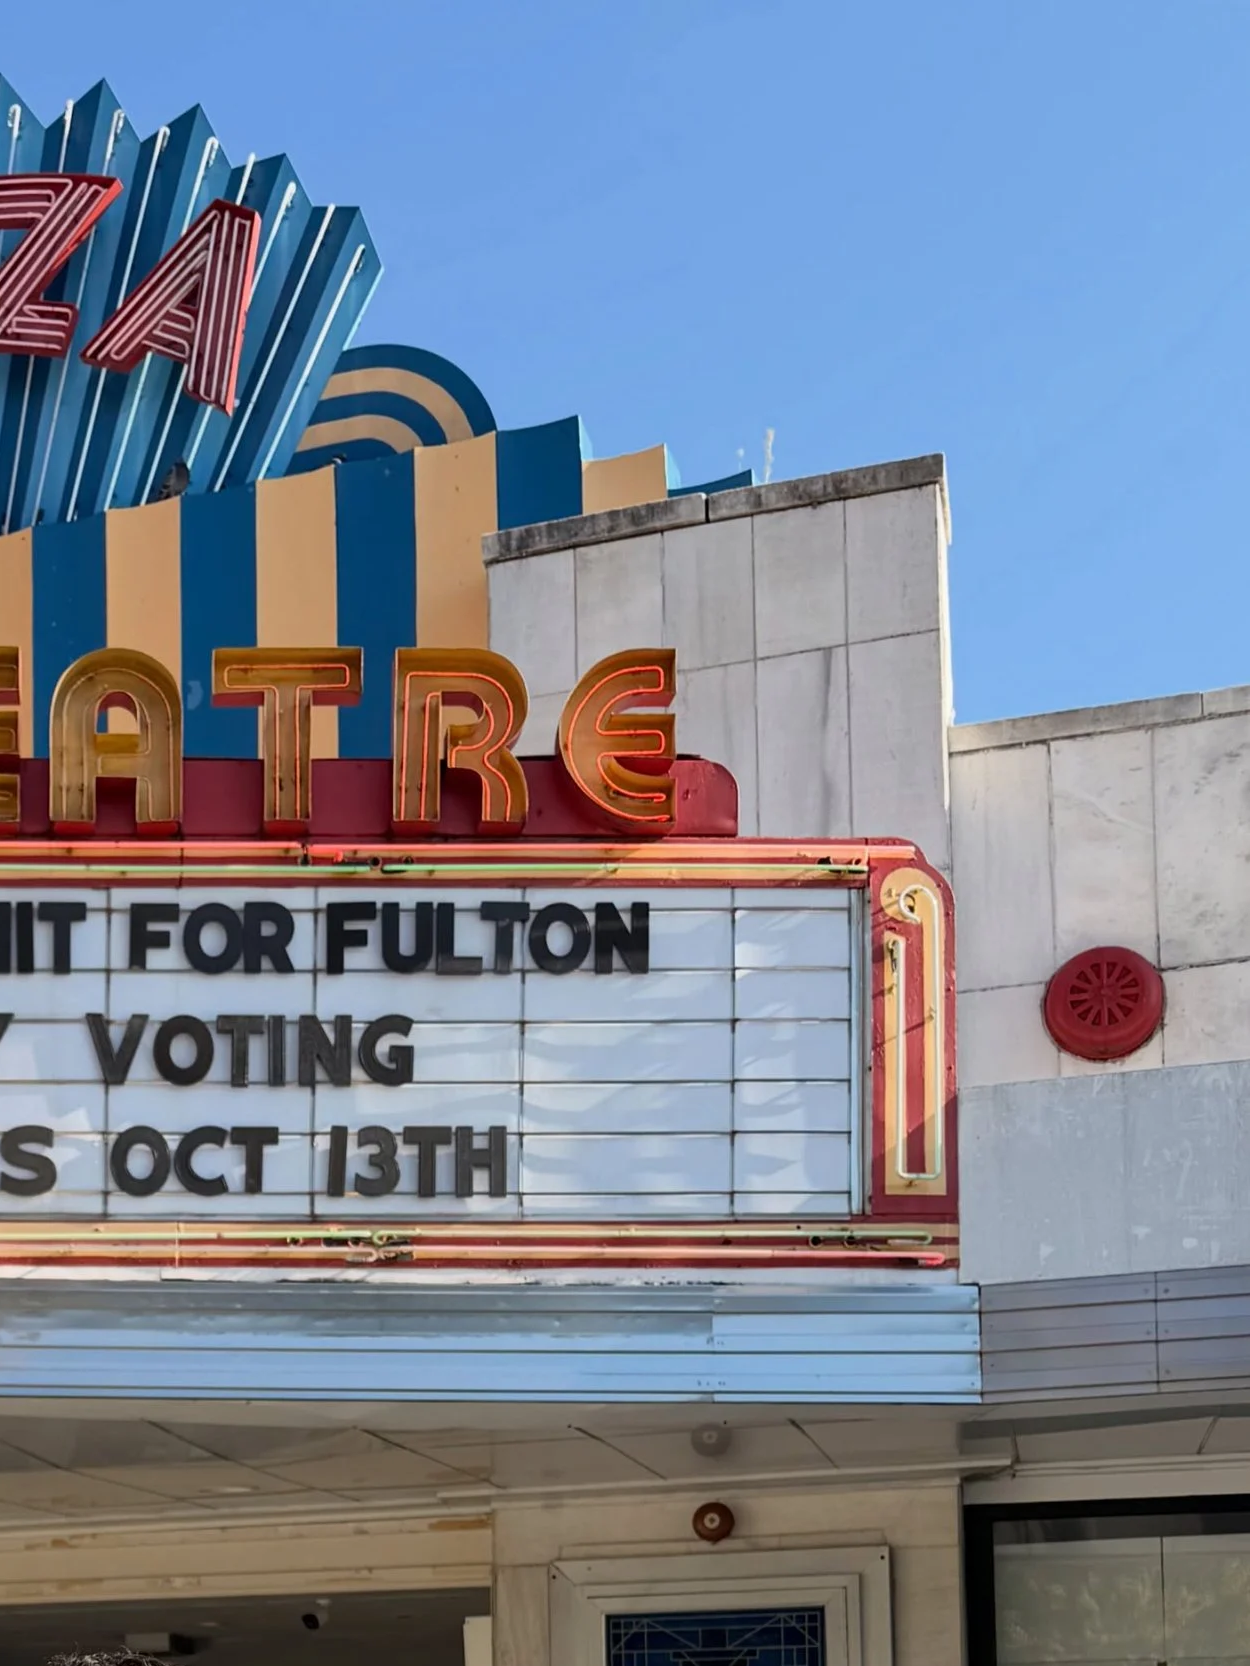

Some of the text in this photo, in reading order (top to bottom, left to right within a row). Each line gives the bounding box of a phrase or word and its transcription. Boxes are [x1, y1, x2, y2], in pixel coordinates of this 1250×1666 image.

[129, 901, 296, 975] FOR
[325, 900, 651, 976] FULTON
[85, 1012, 415, 1088] VOTING
[109, 1124, 280, 1198] OCT
[326, 1125, 507, 1199] 13TH
